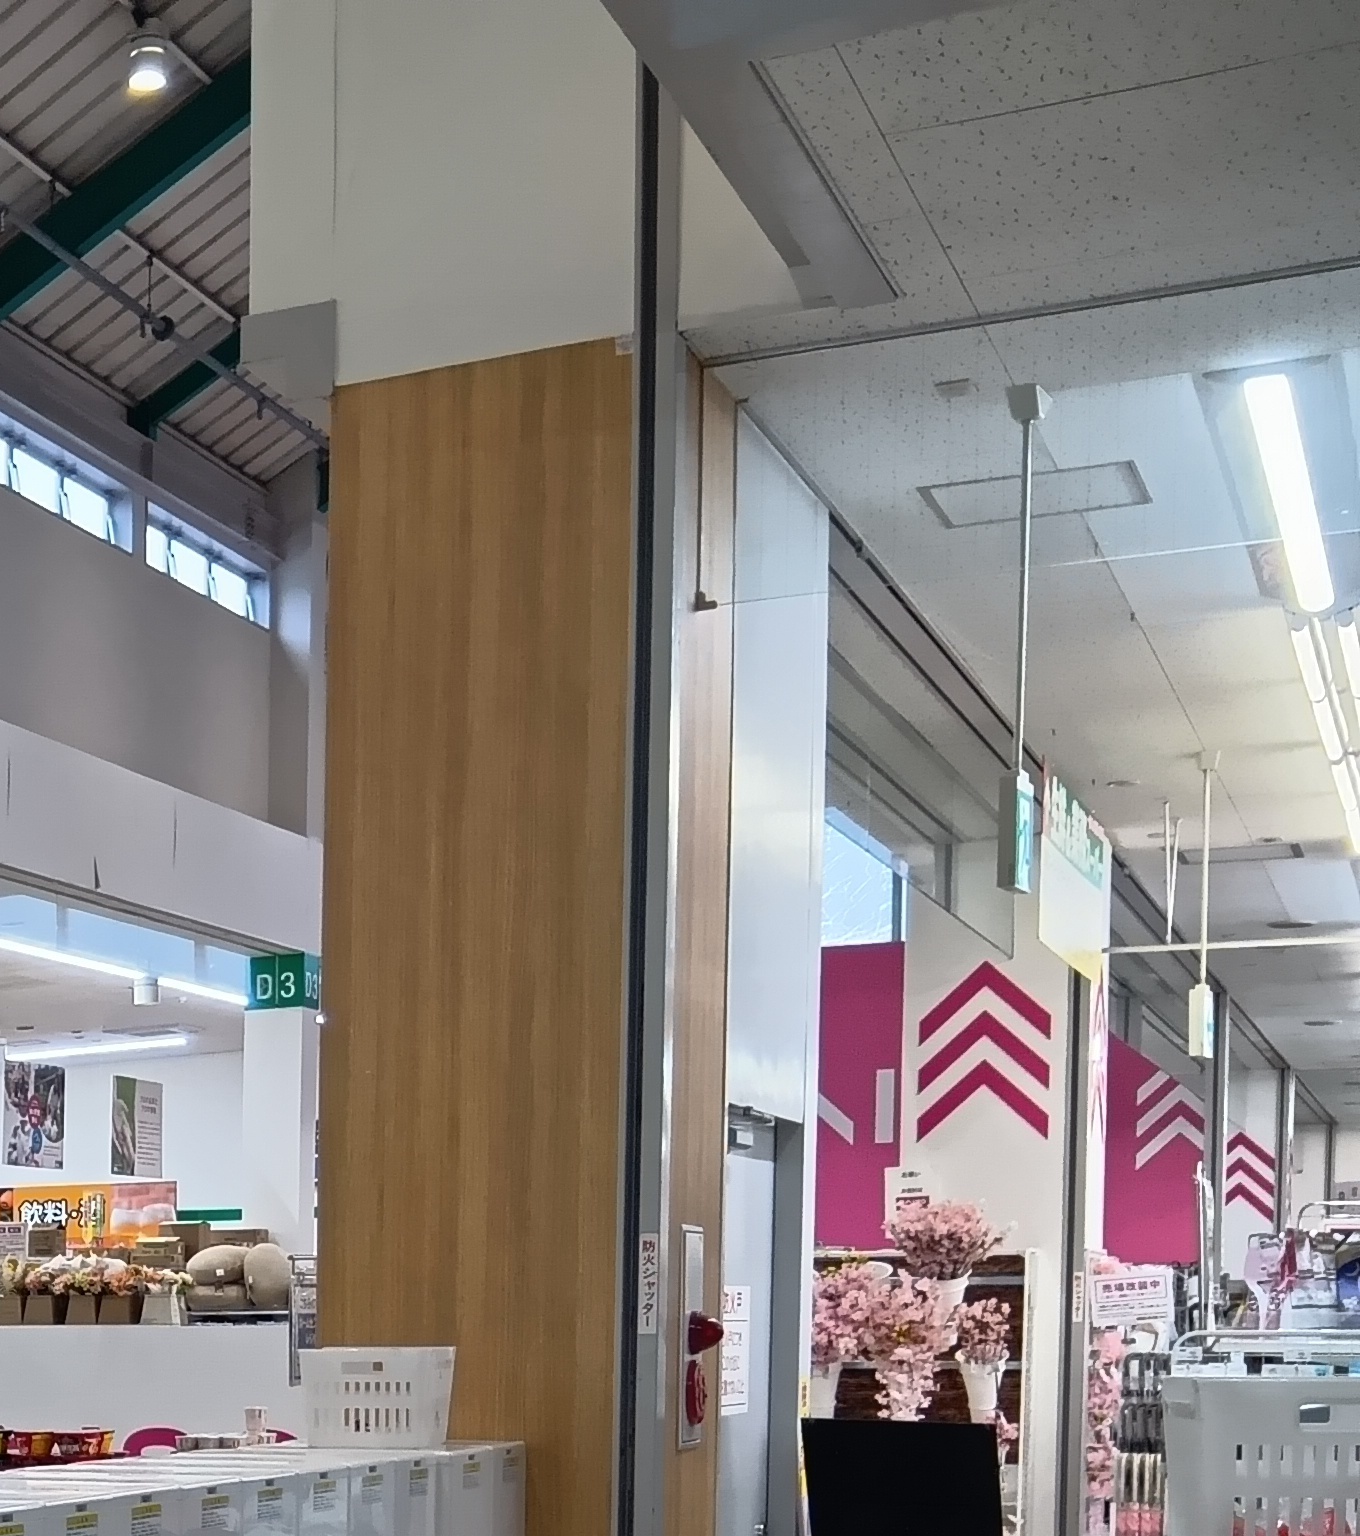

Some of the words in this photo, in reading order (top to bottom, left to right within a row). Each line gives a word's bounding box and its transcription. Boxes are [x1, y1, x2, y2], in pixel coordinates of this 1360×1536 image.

[256, 972, 295, 1000] D3
[305, 971, 318, 1000] D3
[642, 1240, 657, 1327] 防火シャッター
